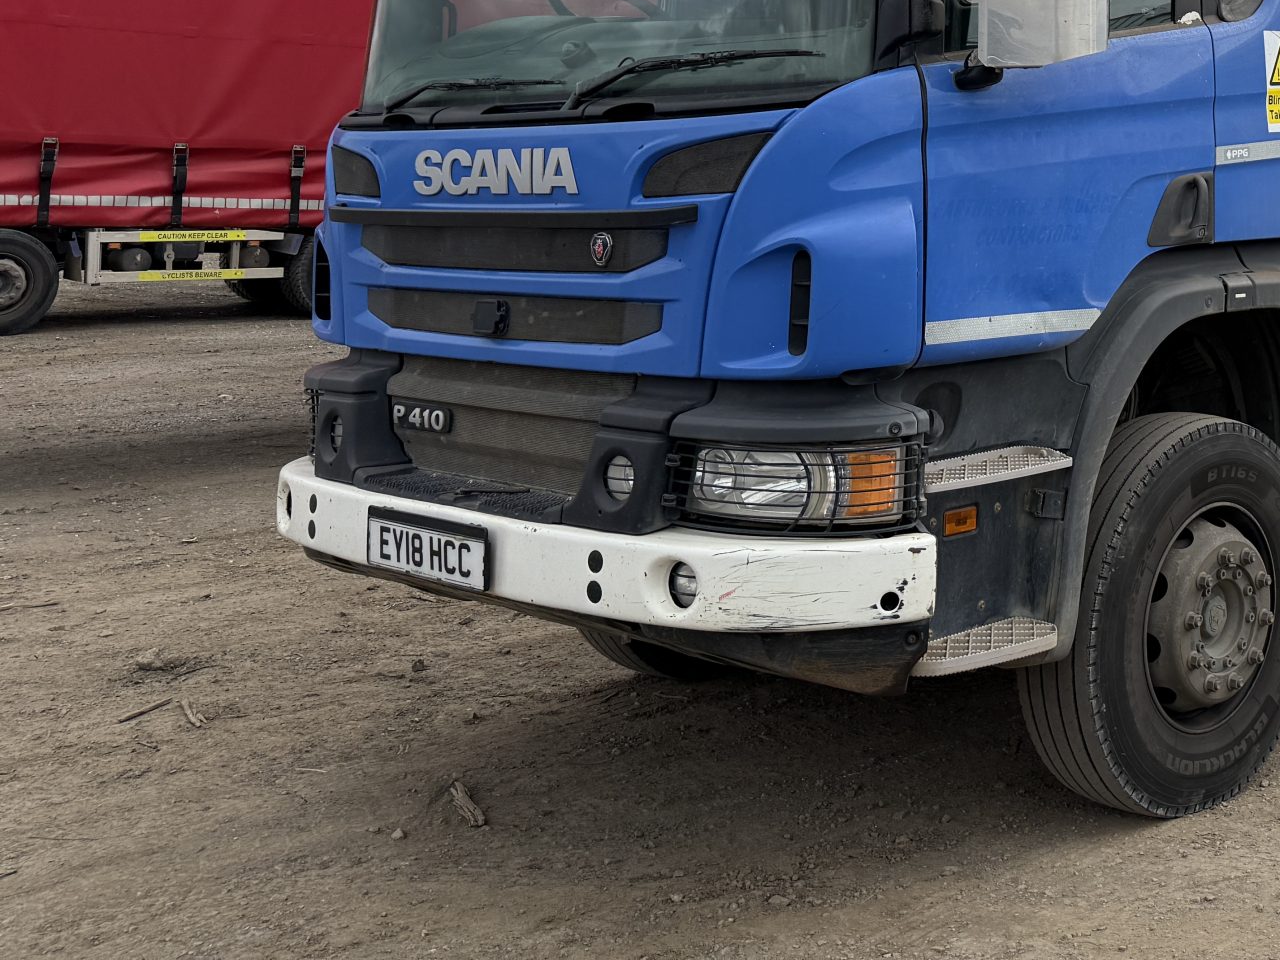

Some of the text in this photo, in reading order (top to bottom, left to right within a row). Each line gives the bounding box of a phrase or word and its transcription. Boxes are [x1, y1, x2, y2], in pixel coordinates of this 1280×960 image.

[412, 147, 579, 196] SCANIA
[1231, 148, 1249, 158] PPG
[393, 405, 445, 431] P 410
[380, 526, 471, 578] EY18 HCC
